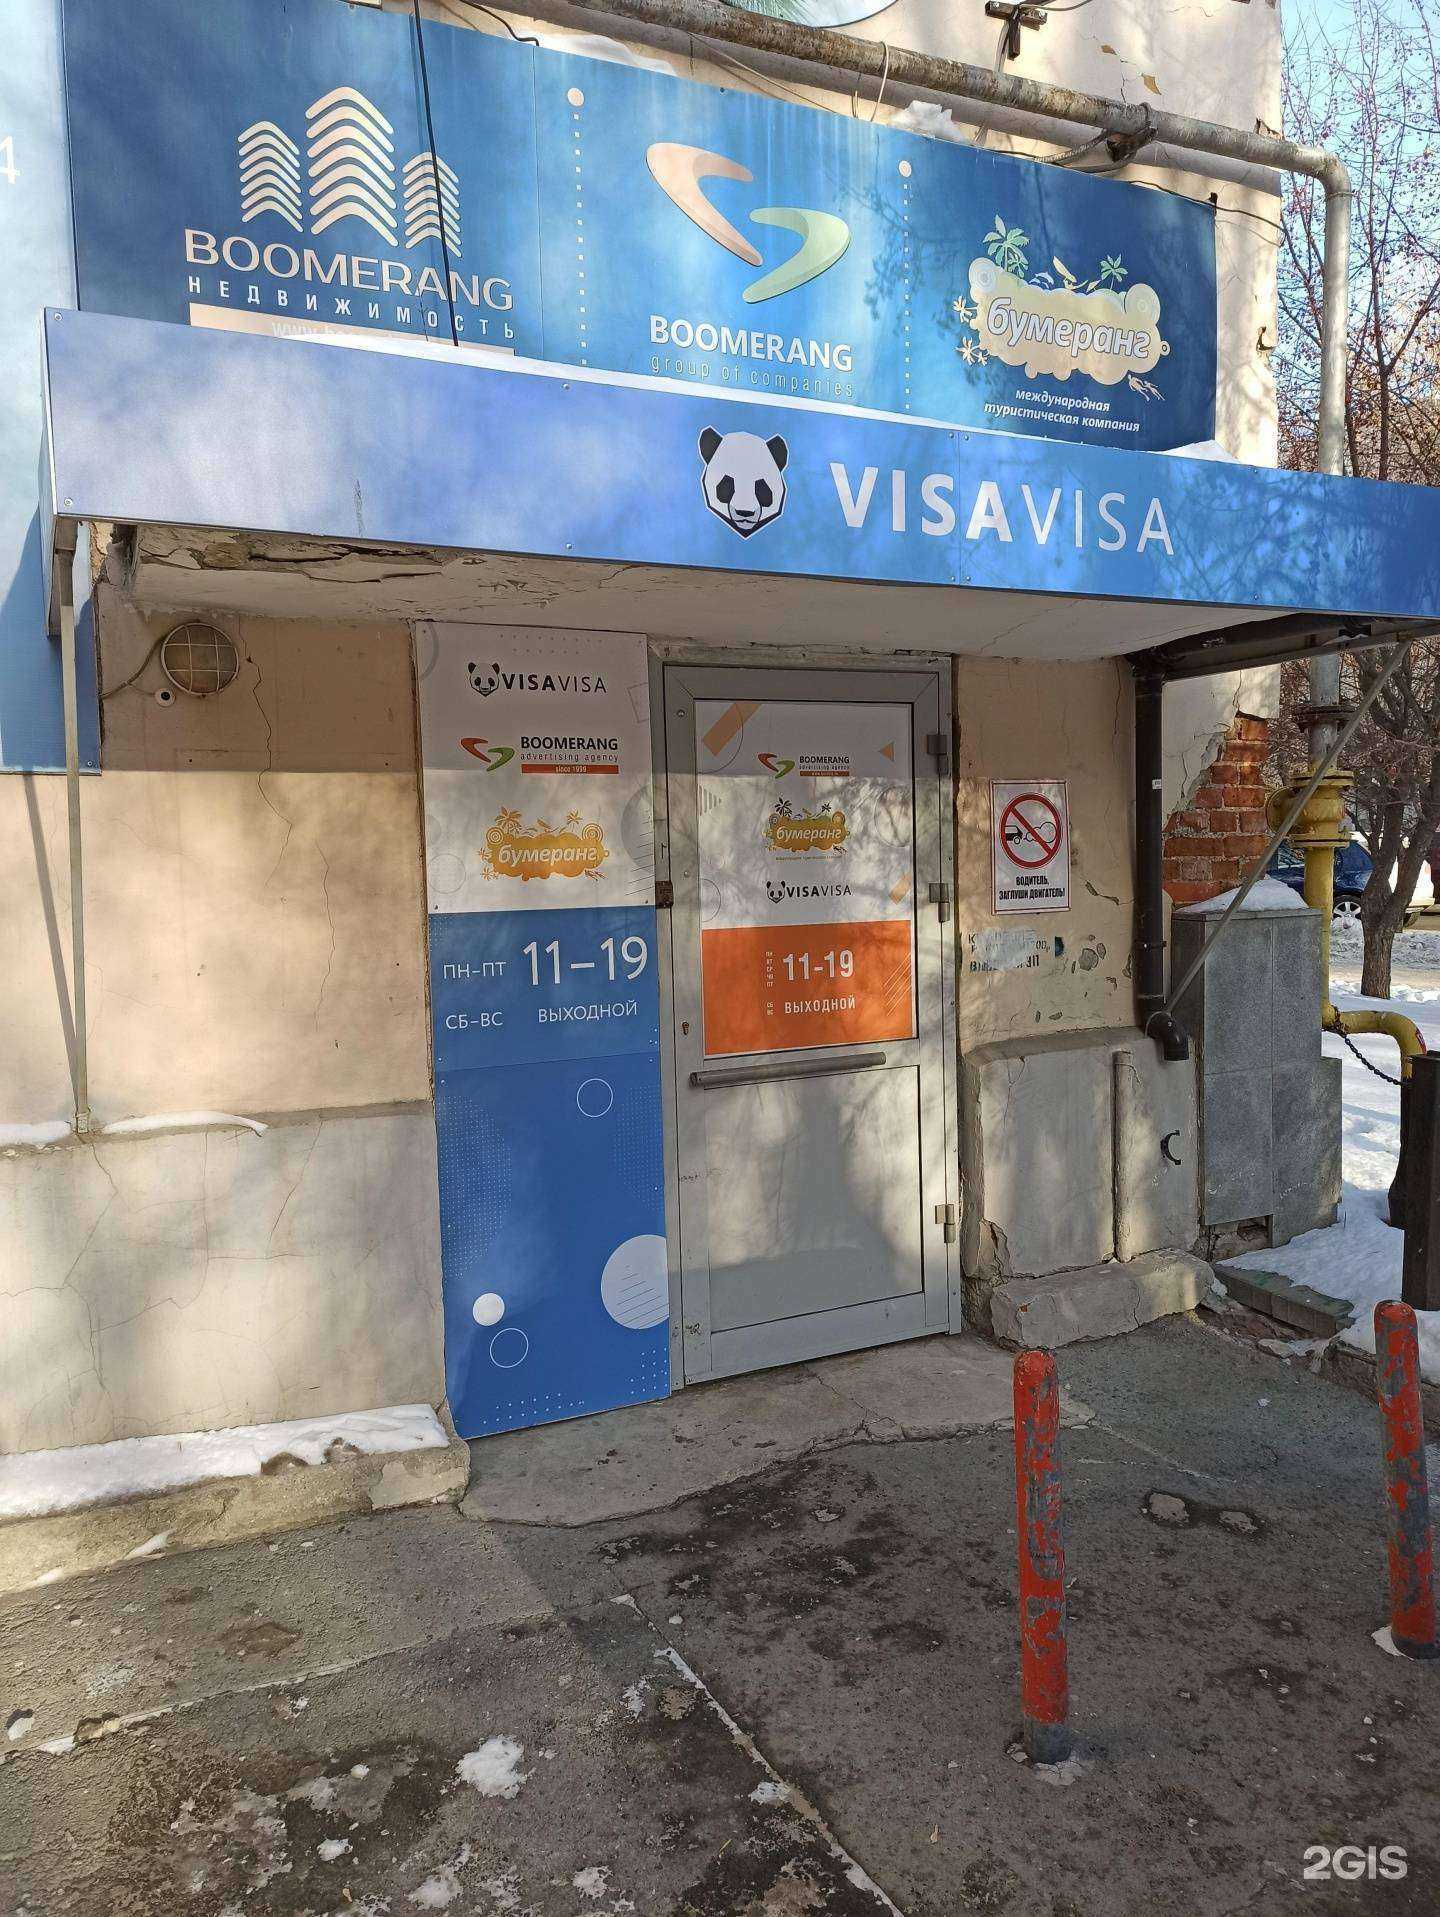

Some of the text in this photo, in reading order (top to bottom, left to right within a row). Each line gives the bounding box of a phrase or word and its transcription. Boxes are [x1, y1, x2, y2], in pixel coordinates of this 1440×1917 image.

[184, 228, 514, 312] BOOMERANG
[188, 275, 515, 340] НЕДВИЖИМОСТЬ
[987, 297, 1152, 359] бумеранг
[650, 314, 853, 372] BOOMERANG
[651, 354, 853, 397] group of companies
[1015, 389, 1111, 412] международная
[984, 402, 1140, 433] туристическая компания
[829, 462, 1174, 556] VISAVISA
[501, 673, 607, 694] VISAVISA
[520, 736, 619, 751] BOOMERANG
[520, 752, 619, 763] advertising agency
[799, 756, 849, 764] BOOMERANG
[776, 826, 842, 842] бумеранг
[498, 844, 598, 868] бумеранг
[786, 885, 852, 898] VISAVISA
[1015, 875, 1050, 887] ВОДИТЕЛЬ,
[998, 889, 1028, 900] ЗАГЛУШИ
[538, 1000, 637, 1023] ВЫХОДНОЙ
[785, 994, 856, 1014] ВЫХОДНОЙ
